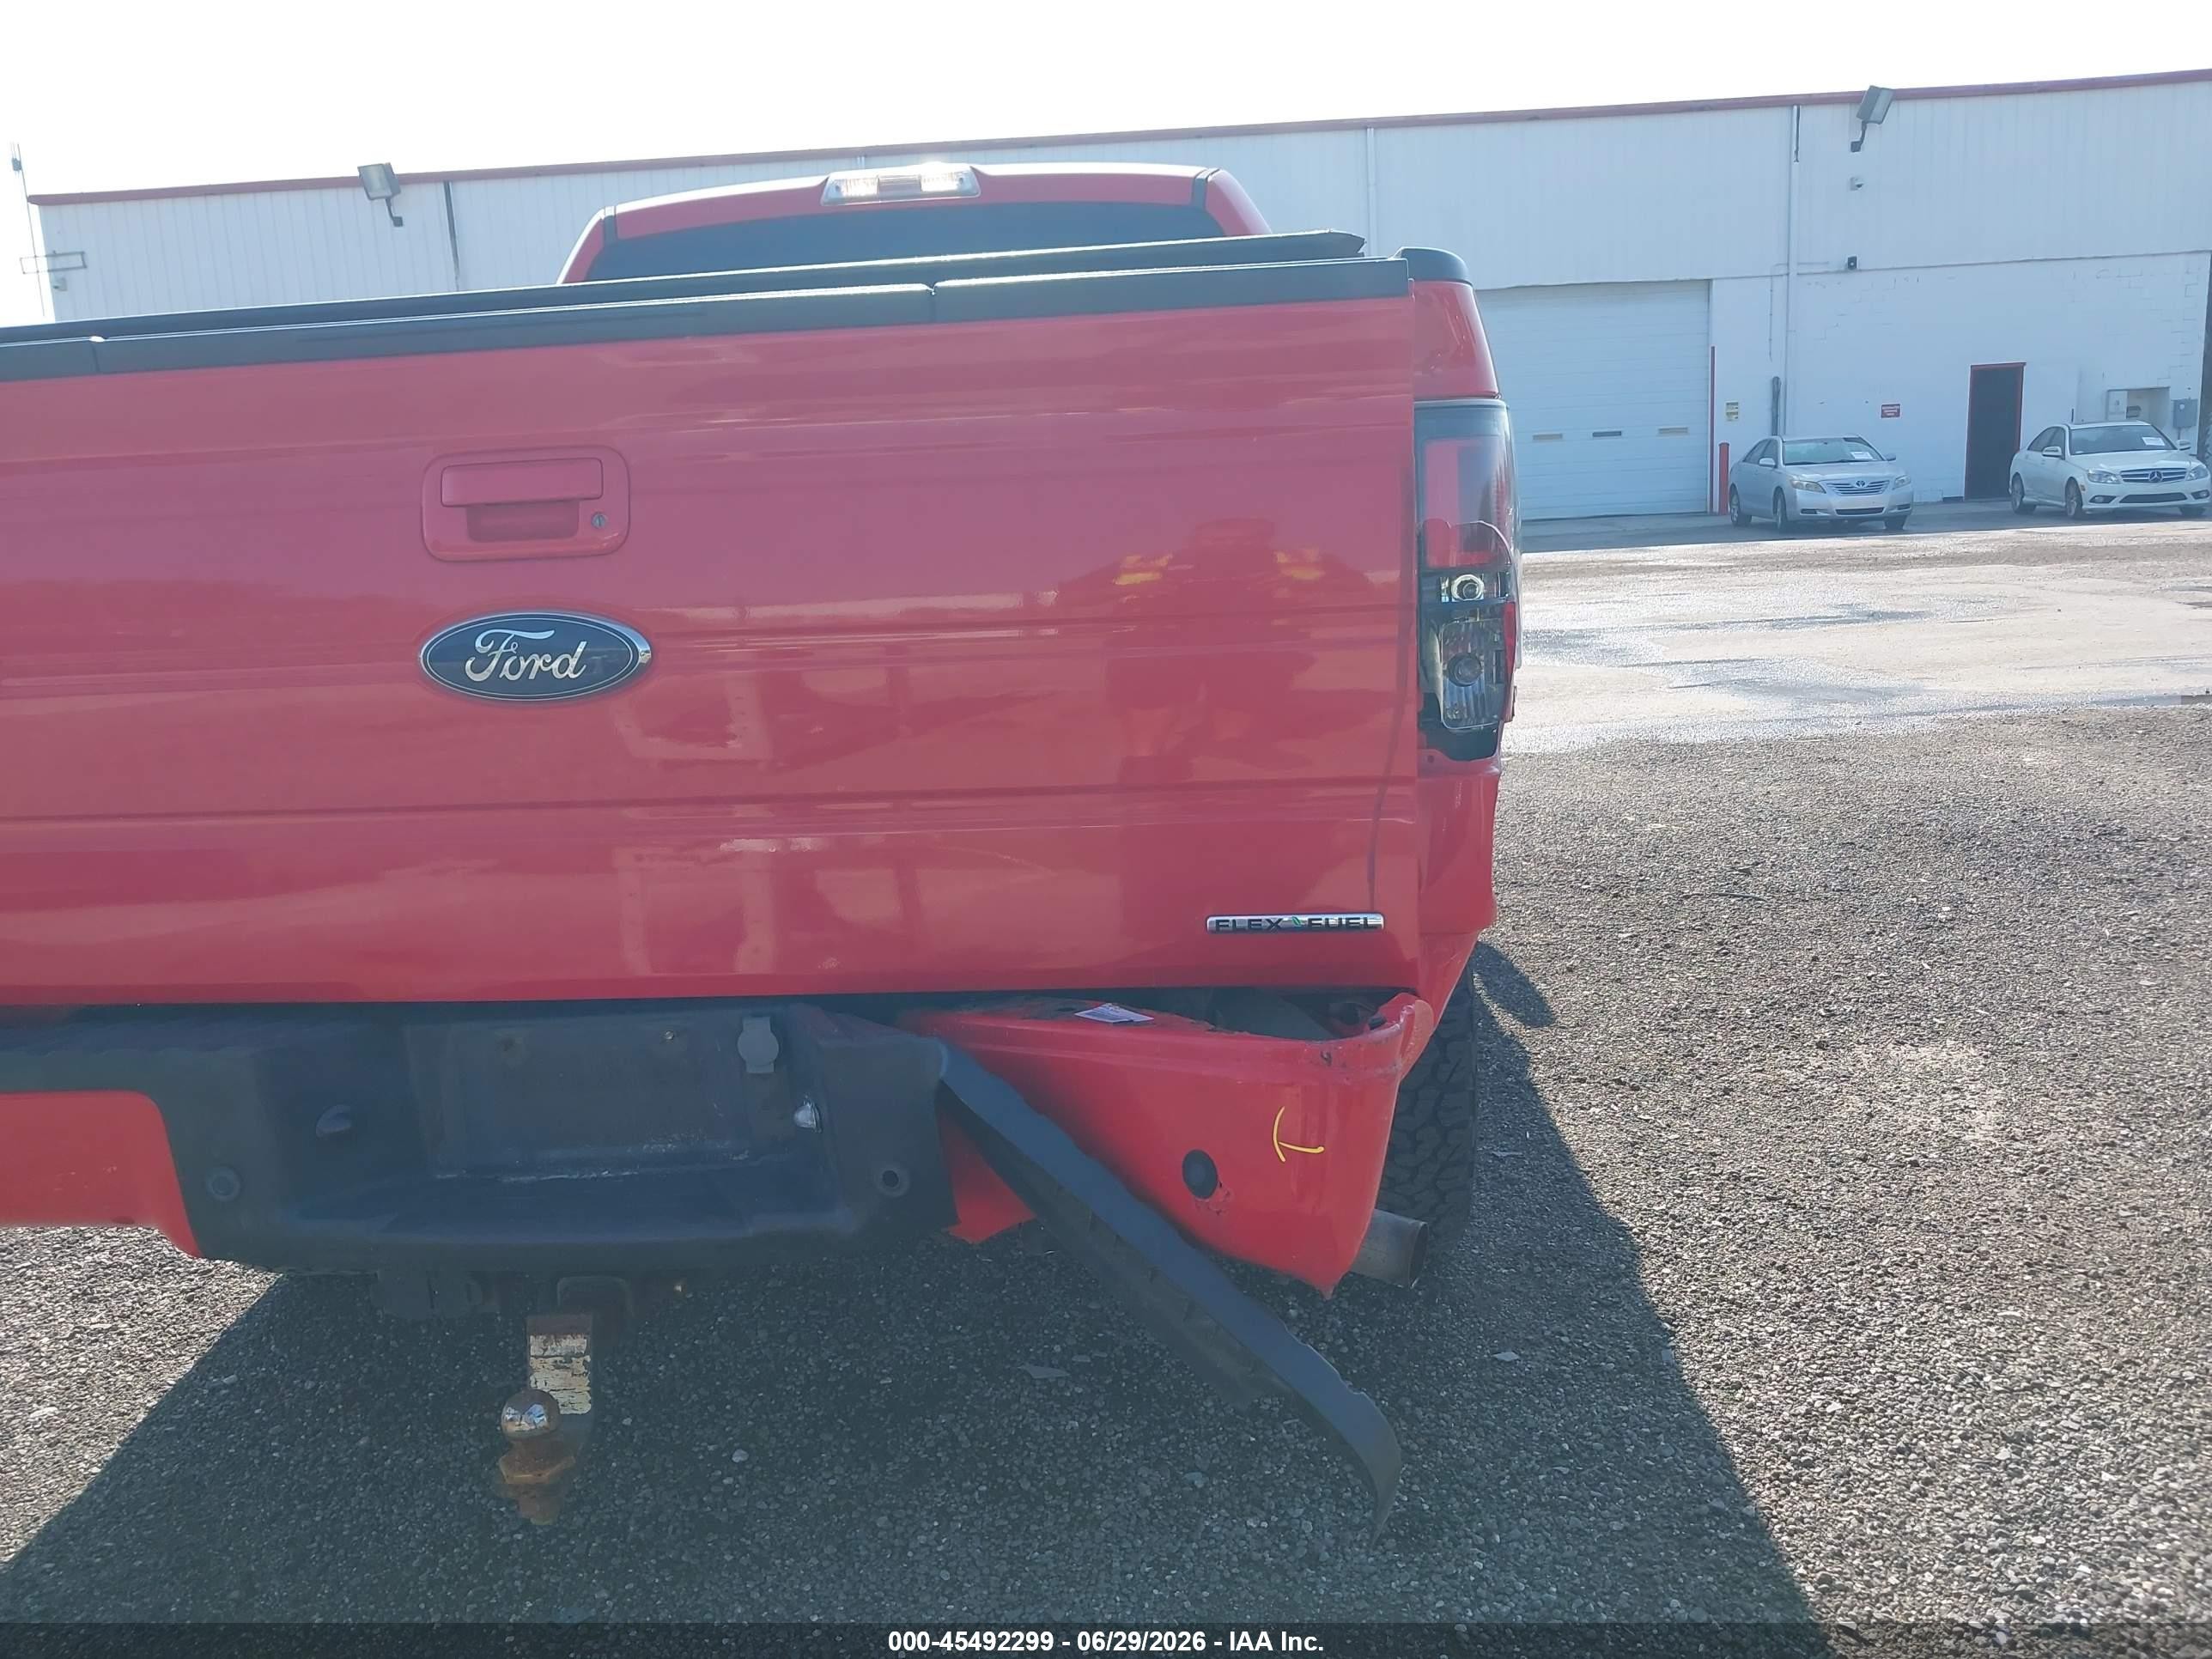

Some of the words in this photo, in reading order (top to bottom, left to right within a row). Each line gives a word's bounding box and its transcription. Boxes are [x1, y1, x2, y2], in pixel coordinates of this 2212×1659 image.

[465, 629, 587, 682] Ford
[1214, 918, 1284, 931] FLEX
[1306, 916, 1382, 930] FUEL
